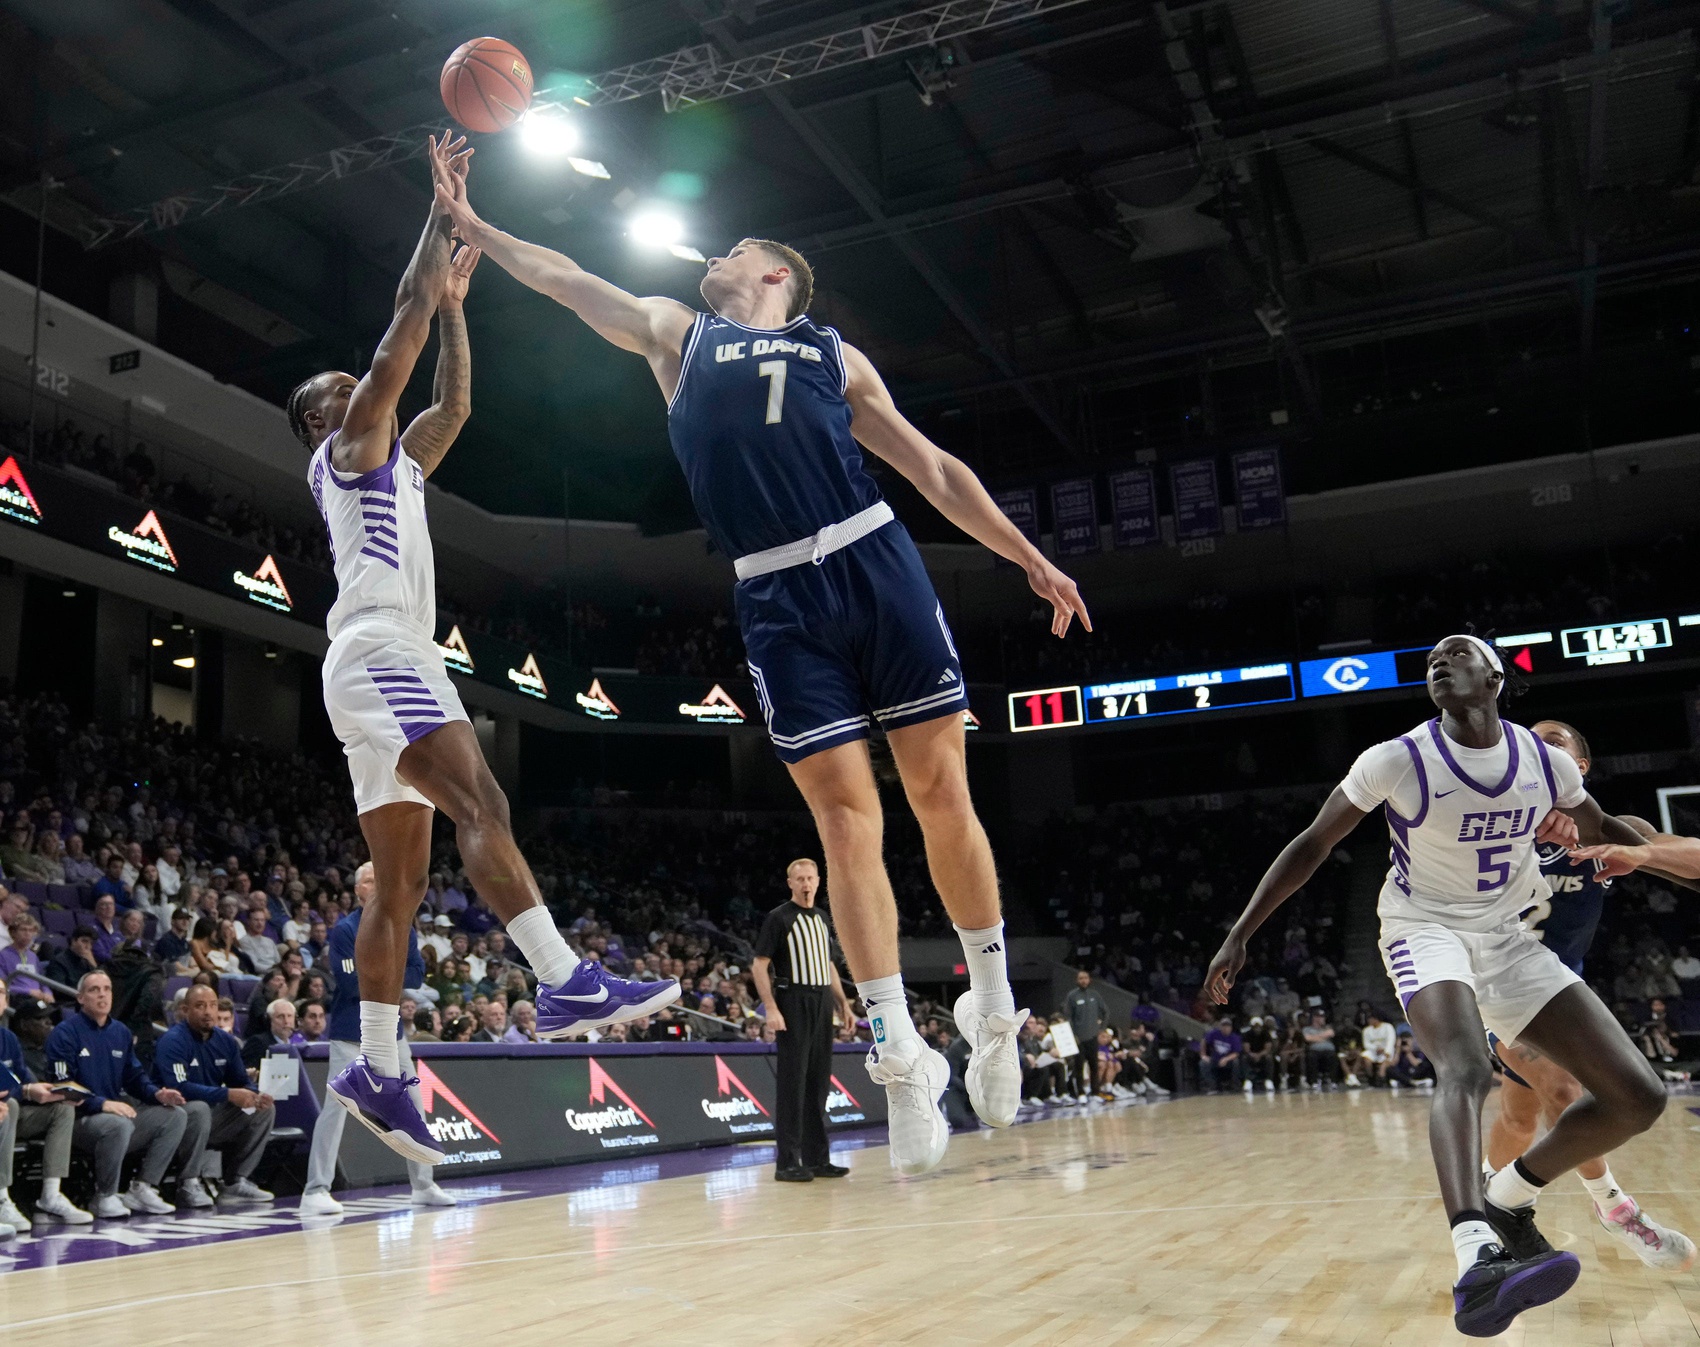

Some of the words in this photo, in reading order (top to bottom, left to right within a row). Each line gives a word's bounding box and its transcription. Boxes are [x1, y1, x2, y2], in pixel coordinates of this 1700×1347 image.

[715, 342, 746, 363] UC
[752, 339, 822, 362] DAVIS
[37, 364, 69, 396] 212
[759, 360, 787, 425] 7
[1530, 485, 1573, 506] 208
[1063, 525, 1091, 541] 2021
[1120, 517, 1151, 532] 2024
[1180, 537, 1216, 557] 209
[1583, 622, 1657, 654] 14:25
[1177, 671, 1222, 688] FOULS
[1026, 692, 1064, 726] 11
[1103, 692, 1147, 719] 3/1
[1194, 686, 1211, 709] 2
[1457, 806, 1538, 842] GCU
[1475, 844, 1512, 892] 5
